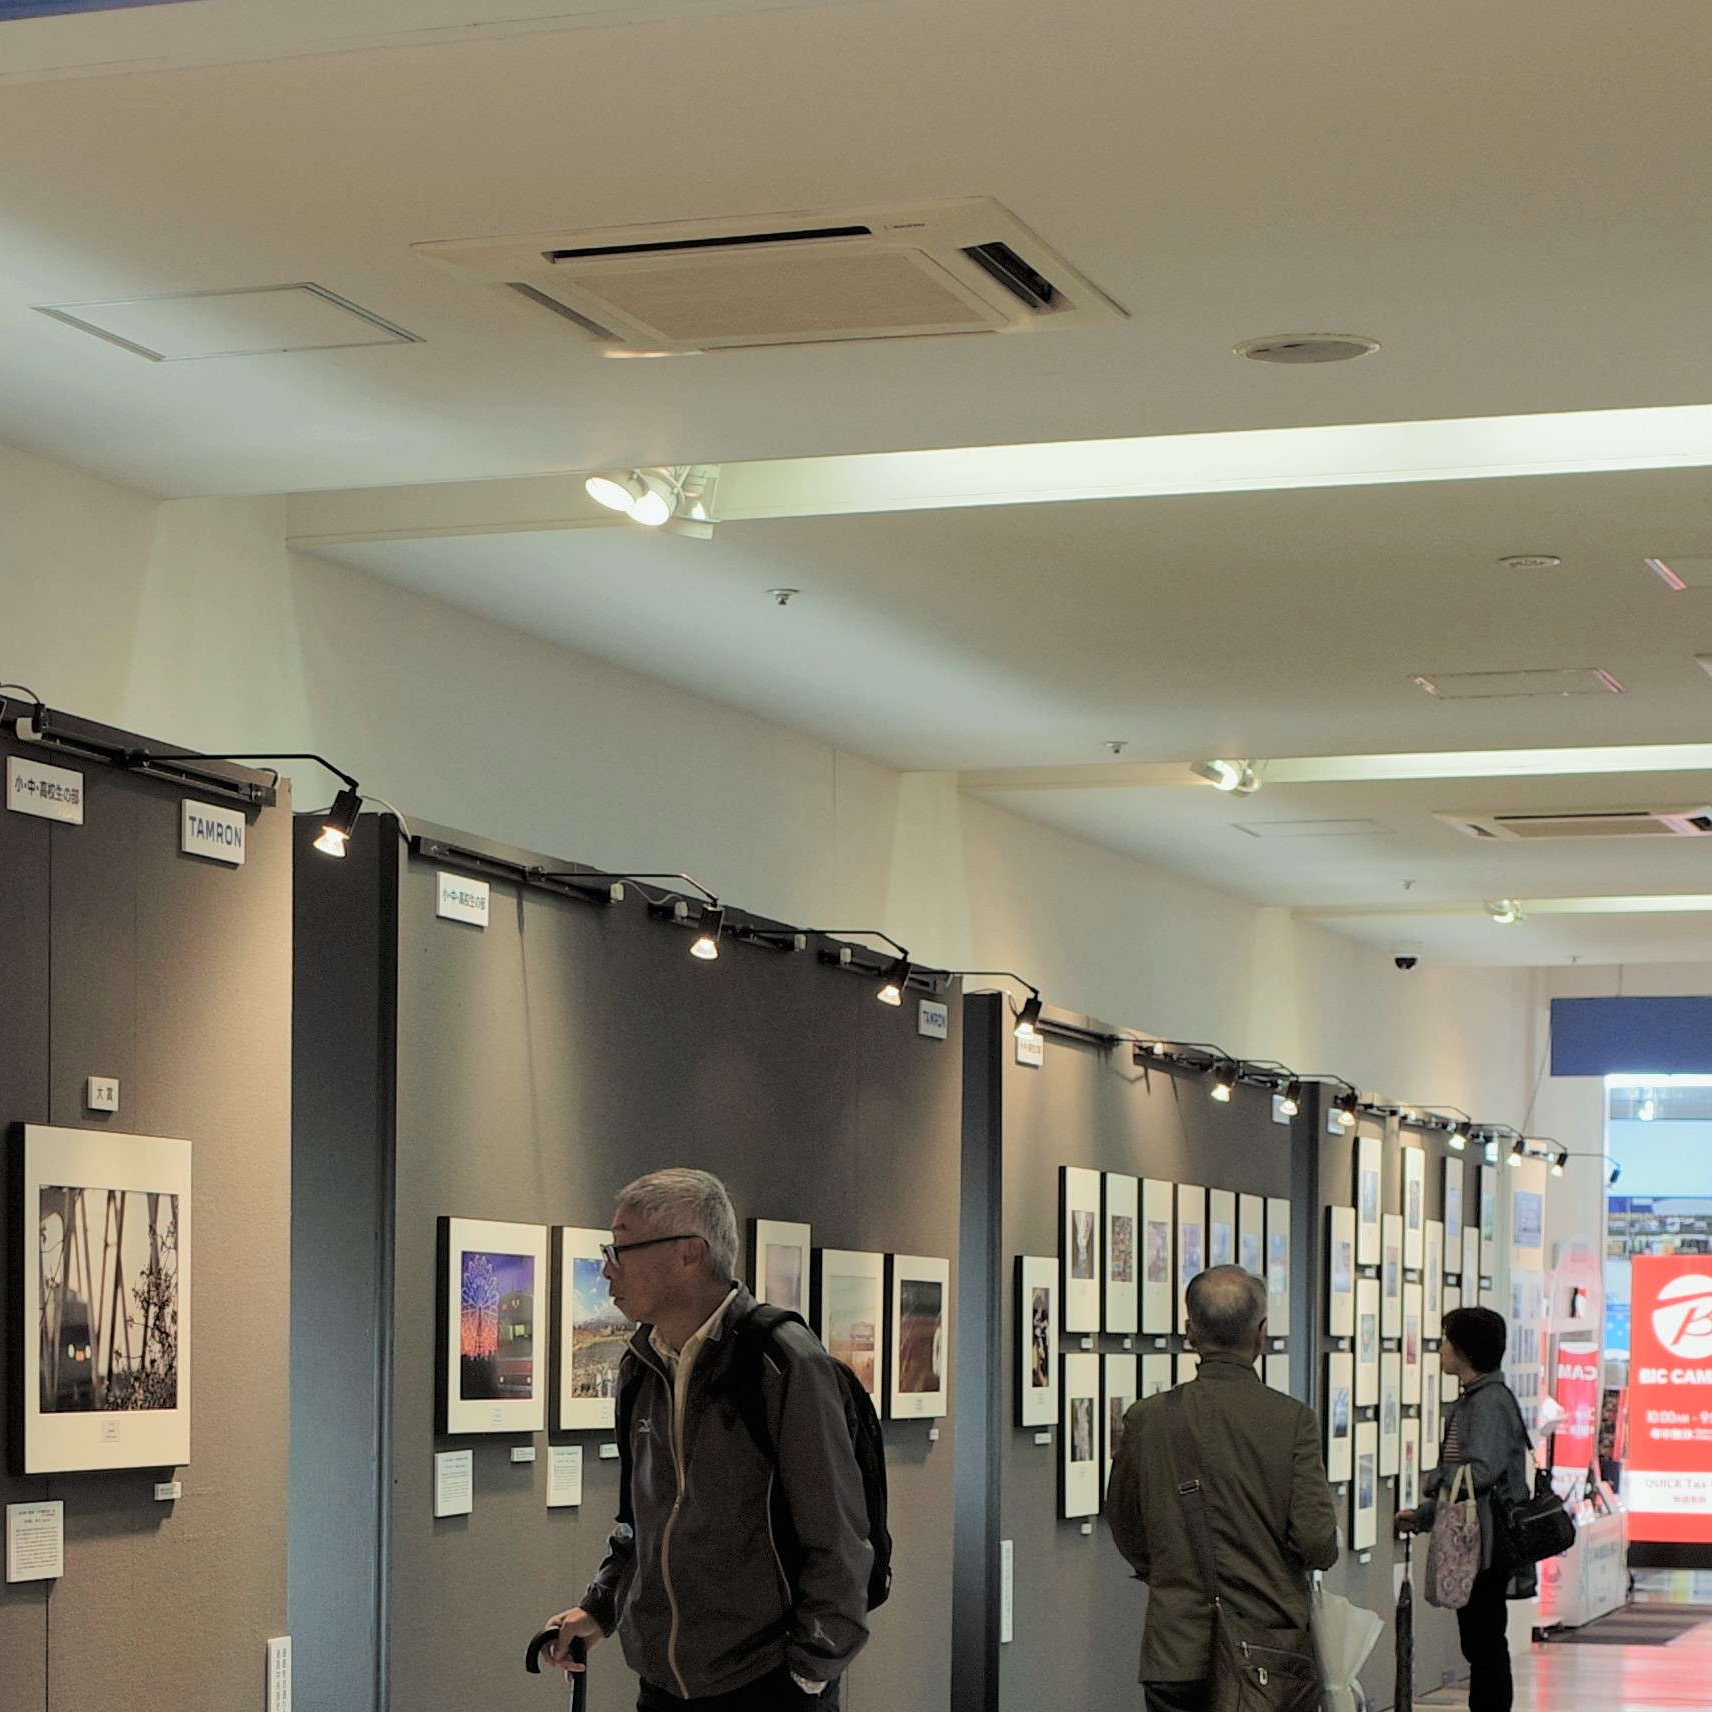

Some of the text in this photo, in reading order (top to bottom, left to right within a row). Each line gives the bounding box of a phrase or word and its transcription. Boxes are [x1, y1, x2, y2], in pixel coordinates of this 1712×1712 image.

[14, 774, 81, 806] 小・中・高校生の部
[189, 814, 243, 849] TAMRON
[1639, 1368, 1668, 1385] BIC
